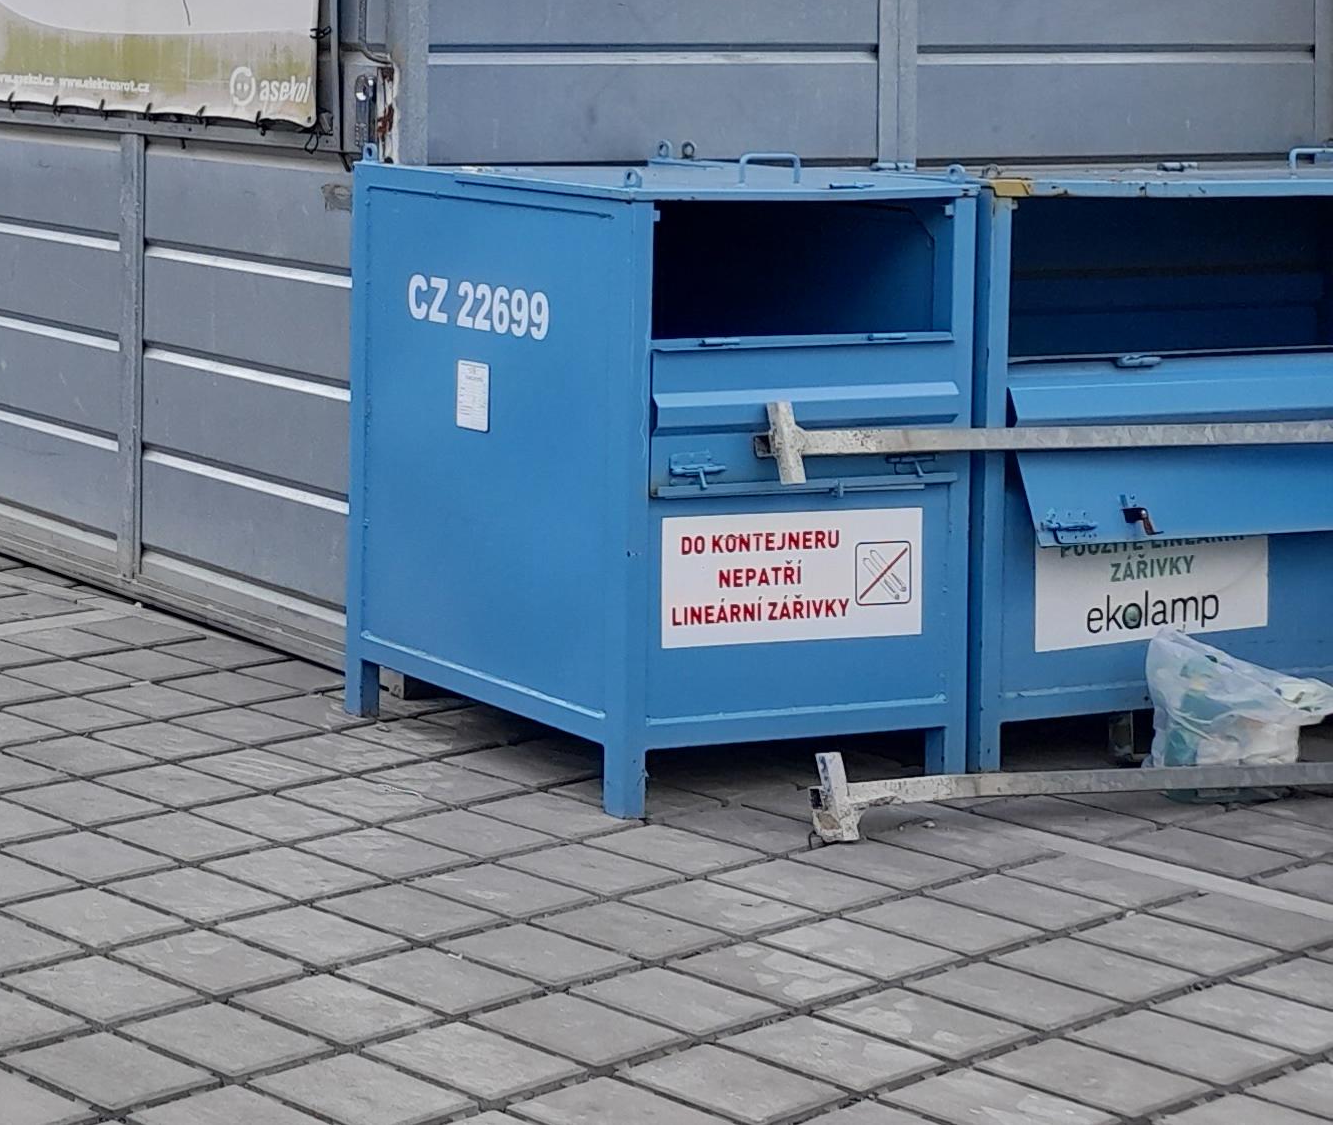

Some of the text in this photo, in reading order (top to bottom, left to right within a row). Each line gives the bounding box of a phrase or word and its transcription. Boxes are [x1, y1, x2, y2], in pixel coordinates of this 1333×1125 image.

[259, 75, 312, 103] asekol
[408, 274, 550, 341] CZ 22699
[681, 529, 840, 555] DO KONTEJNERU
[718, 559, 802, 588] NEPATŘÍ
[1110, 553, 1194, 582] ZÁŘIVKY
[672, 594, 850, 626] LINEÁRNÍ ZÁŘIVKY
[1086, 590, 1220, 634] ekolamp
